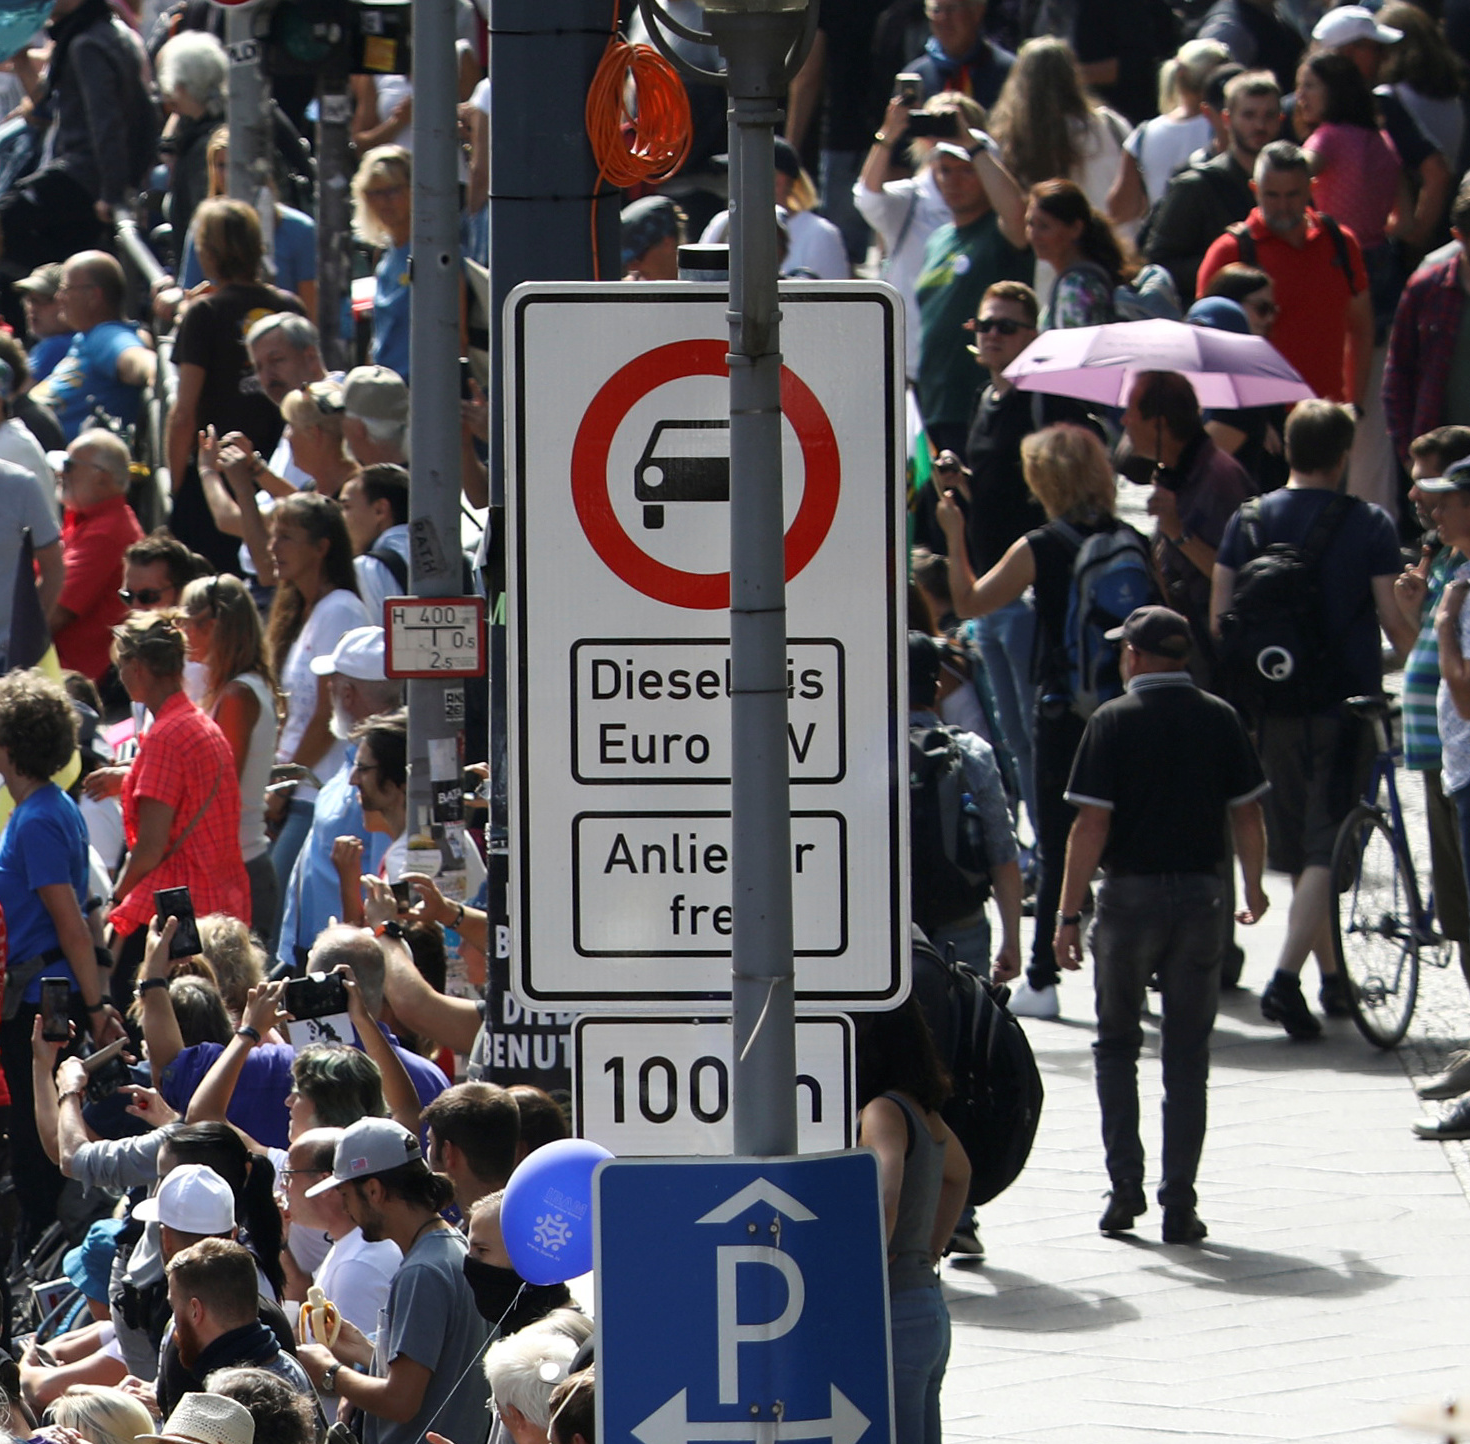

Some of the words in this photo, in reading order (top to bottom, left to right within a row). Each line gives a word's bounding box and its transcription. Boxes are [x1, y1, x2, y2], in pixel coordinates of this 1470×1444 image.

[393, 608, 405, 624] H
[420, 607, 456, 624] 400
[591, 658, 731, 700] Diesel
[787, 658, 824, 699] is
[599, 723, 710, 764] Euro
[603, 832, 816, 874] Anlier
[670, 894, 732, 935] fre
[603, 1055, 729, 1124] 100
